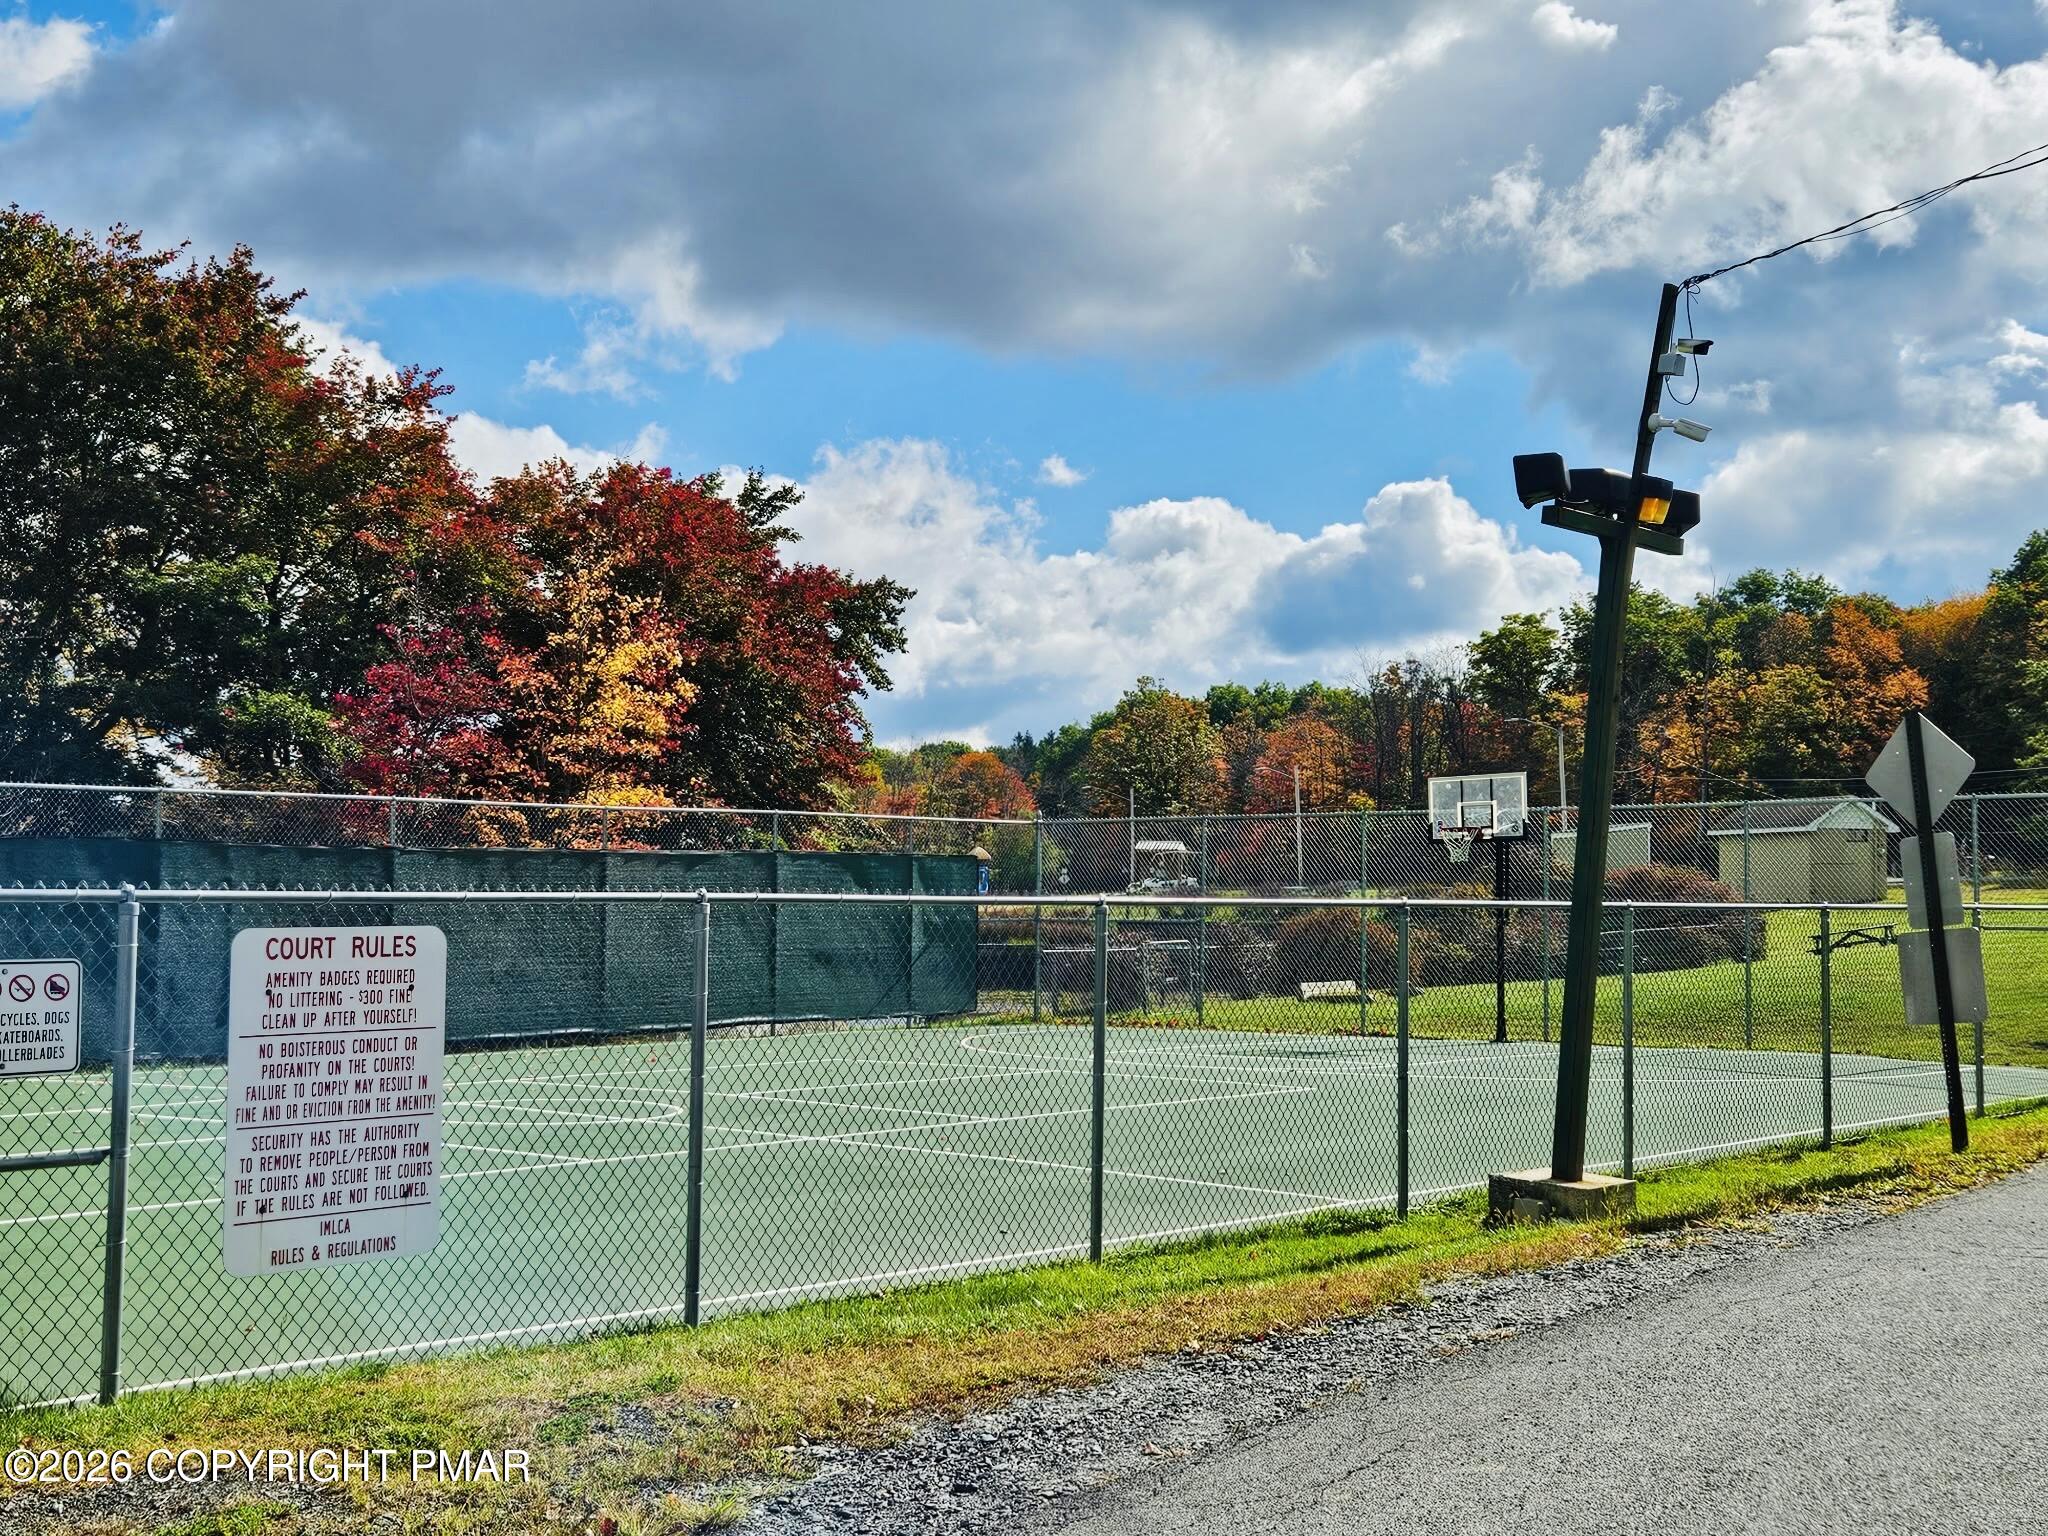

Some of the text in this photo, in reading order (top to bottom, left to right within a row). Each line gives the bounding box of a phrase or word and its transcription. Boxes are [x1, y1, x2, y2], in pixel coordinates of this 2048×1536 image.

[266, 935, 416, 960] COURT RULES
[266, 969, 415, 988] AMENITY BADGES REQUIRED
[268, 992, 282, 1008] NO
[290, 991, 342, 1007] LITTERING
[359, 990, 383, 1004] $300
[389, 989, 411, 1003] FINE
[45, 1012, 69, 1024] DOGS
[262, 1009, 417, 1029] CLEAN UP AFTER YOURSELF!
[0, 1046, 64, 1061] LLERBLADES
[259, 1037, 417, 1058] NO BOISTEROUS CONDUCT OR
[261, 1057, 414, 1079] PROFANITY ON THE COURTS!
[246, 1075, 427, 1102] FAILURE TO COMPLY MAY RESULT IN
[236, 1094, 435, 1124] FINE AND OR EVICTION FROM THE AMENITY!
[252, 1123, 419, 1151] SECURITY HAS THE AUTHORITY
[240, 1142, 429, 1174] TO REMOVE PEOPLE/PERSON FROM
[235, 1162, 432, 1195] THE COURTS AND SECURE THE COURTS
[237, 1181, 429, 1216] IF THE RULES ARE NOT FOLLOWED.
[320, 1218, 350, 1236] IMLCA
[271, 1236, 396, 1266] RULES & REGULATIONS
